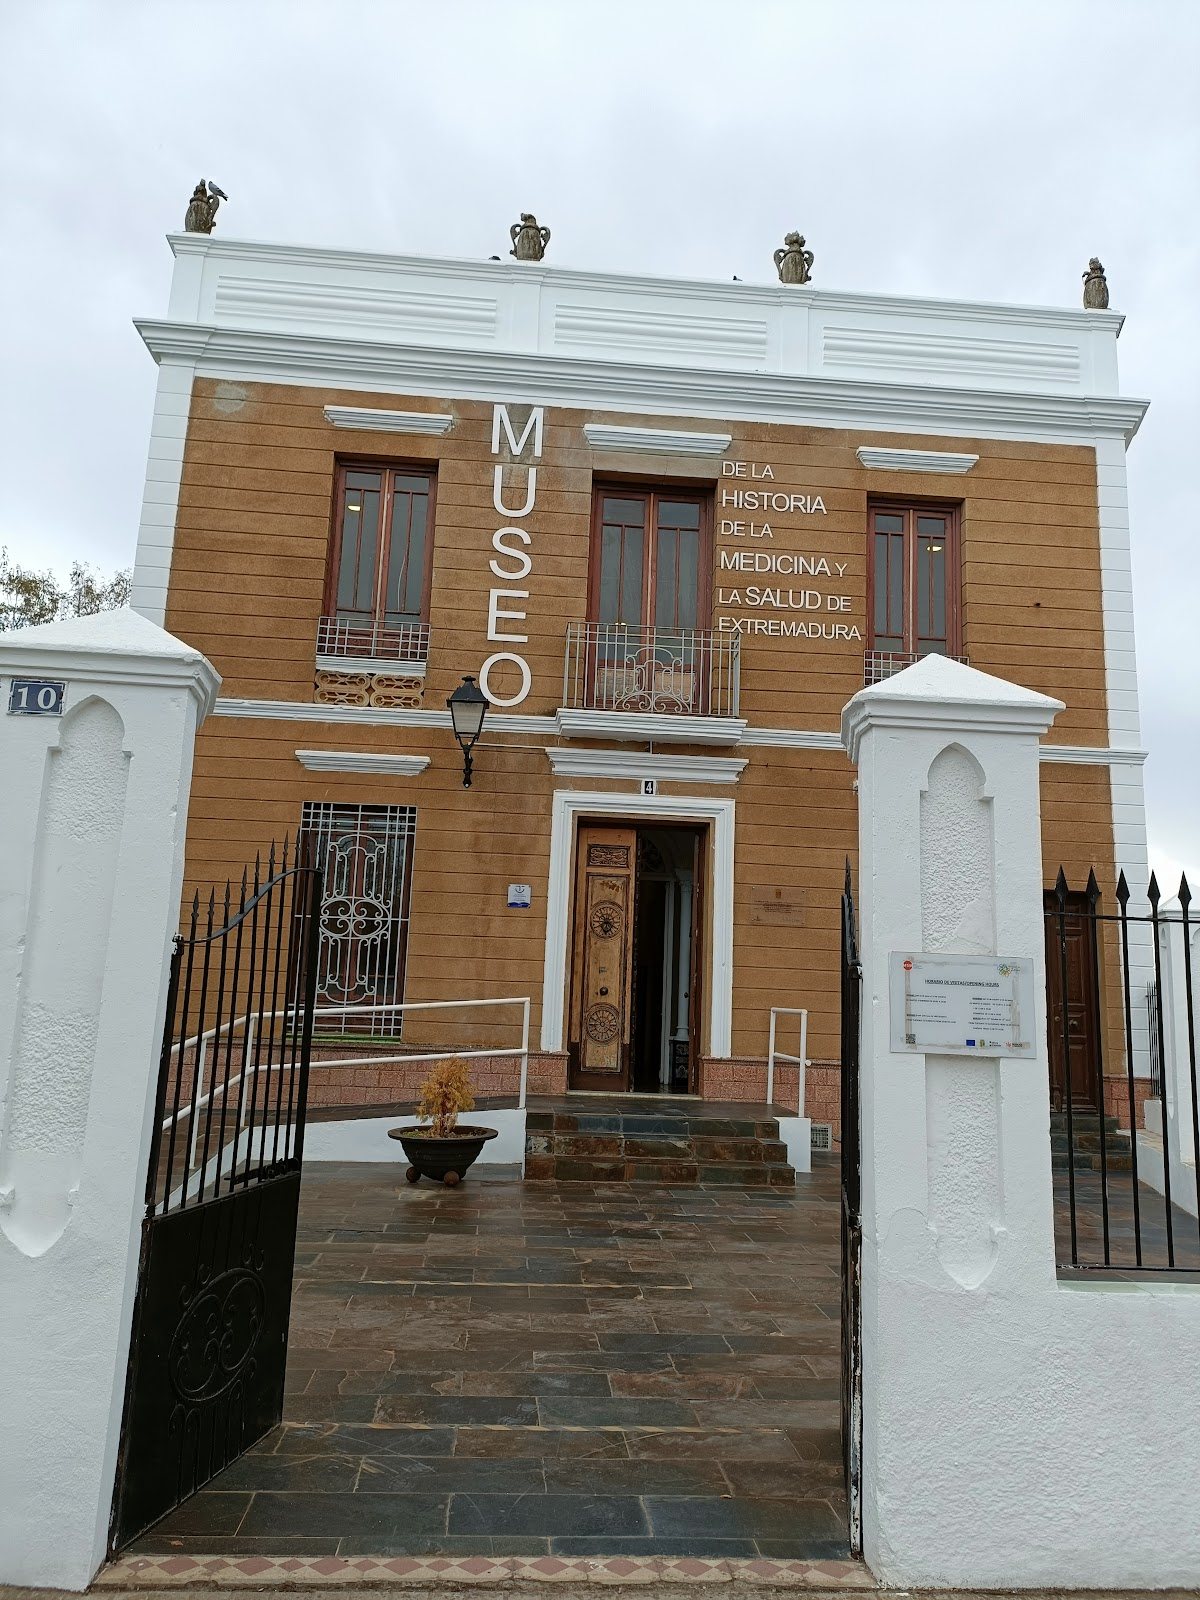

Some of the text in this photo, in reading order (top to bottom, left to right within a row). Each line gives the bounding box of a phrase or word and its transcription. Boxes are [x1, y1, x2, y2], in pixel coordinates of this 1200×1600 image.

[722, 461, 775, 480] DE LA
[721, 489, 828, 515] HISTORIA
[720, 519, 774, 539] DE LA
[479, 404, 544, 707] MUSEO
[720, 550, 848, 578] MEDICINA Y
[718, 586, 852, 612] LA SALUD DE
[718, 616, 862, 641] EXTREMADURA
[17, 686, 57, 710] 10
[645, 781, 653, 794] 4
